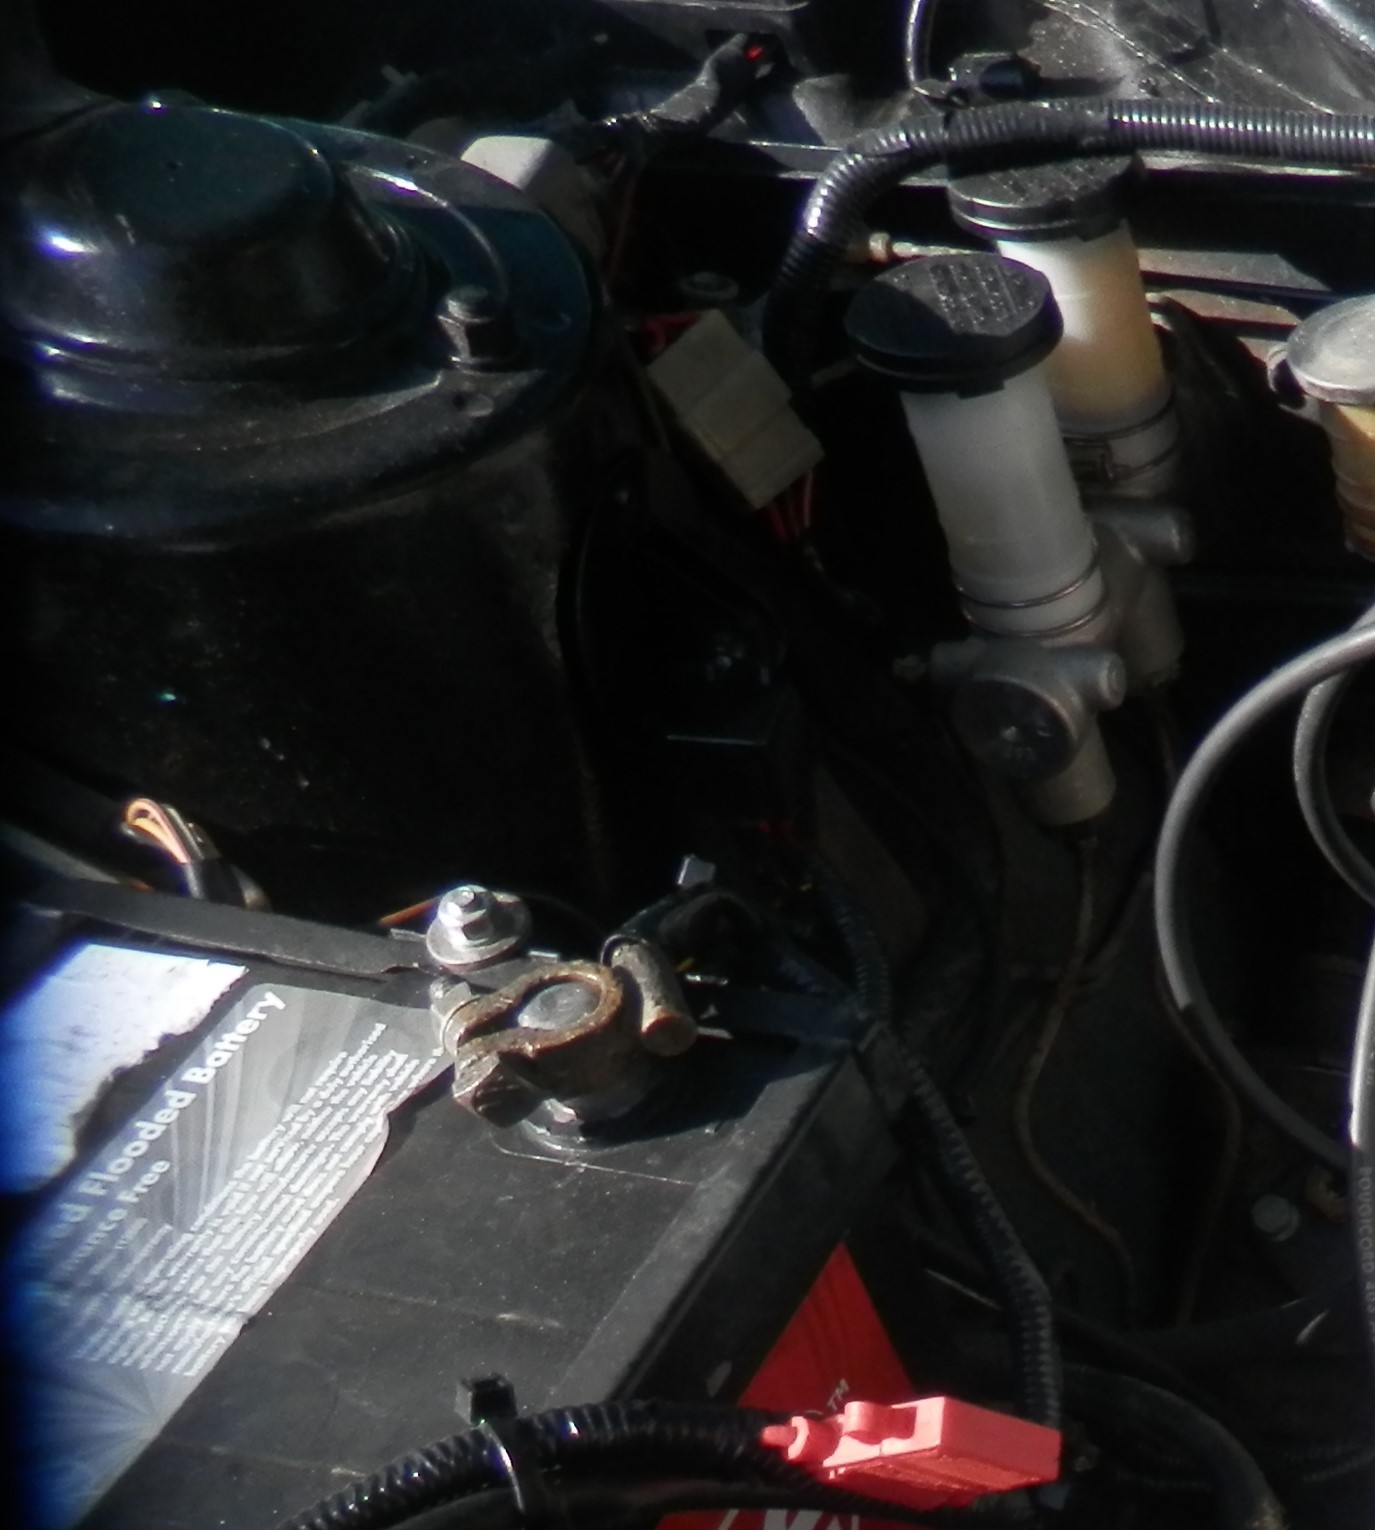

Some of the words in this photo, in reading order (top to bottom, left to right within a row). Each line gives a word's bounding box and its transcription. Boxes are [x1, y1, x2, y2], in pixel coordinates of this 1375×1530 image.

[79, 1089, 196, 1196] Flooded
[182, 991, 286, 1084] Battery
[117, 1159, 171, 1202] Free
